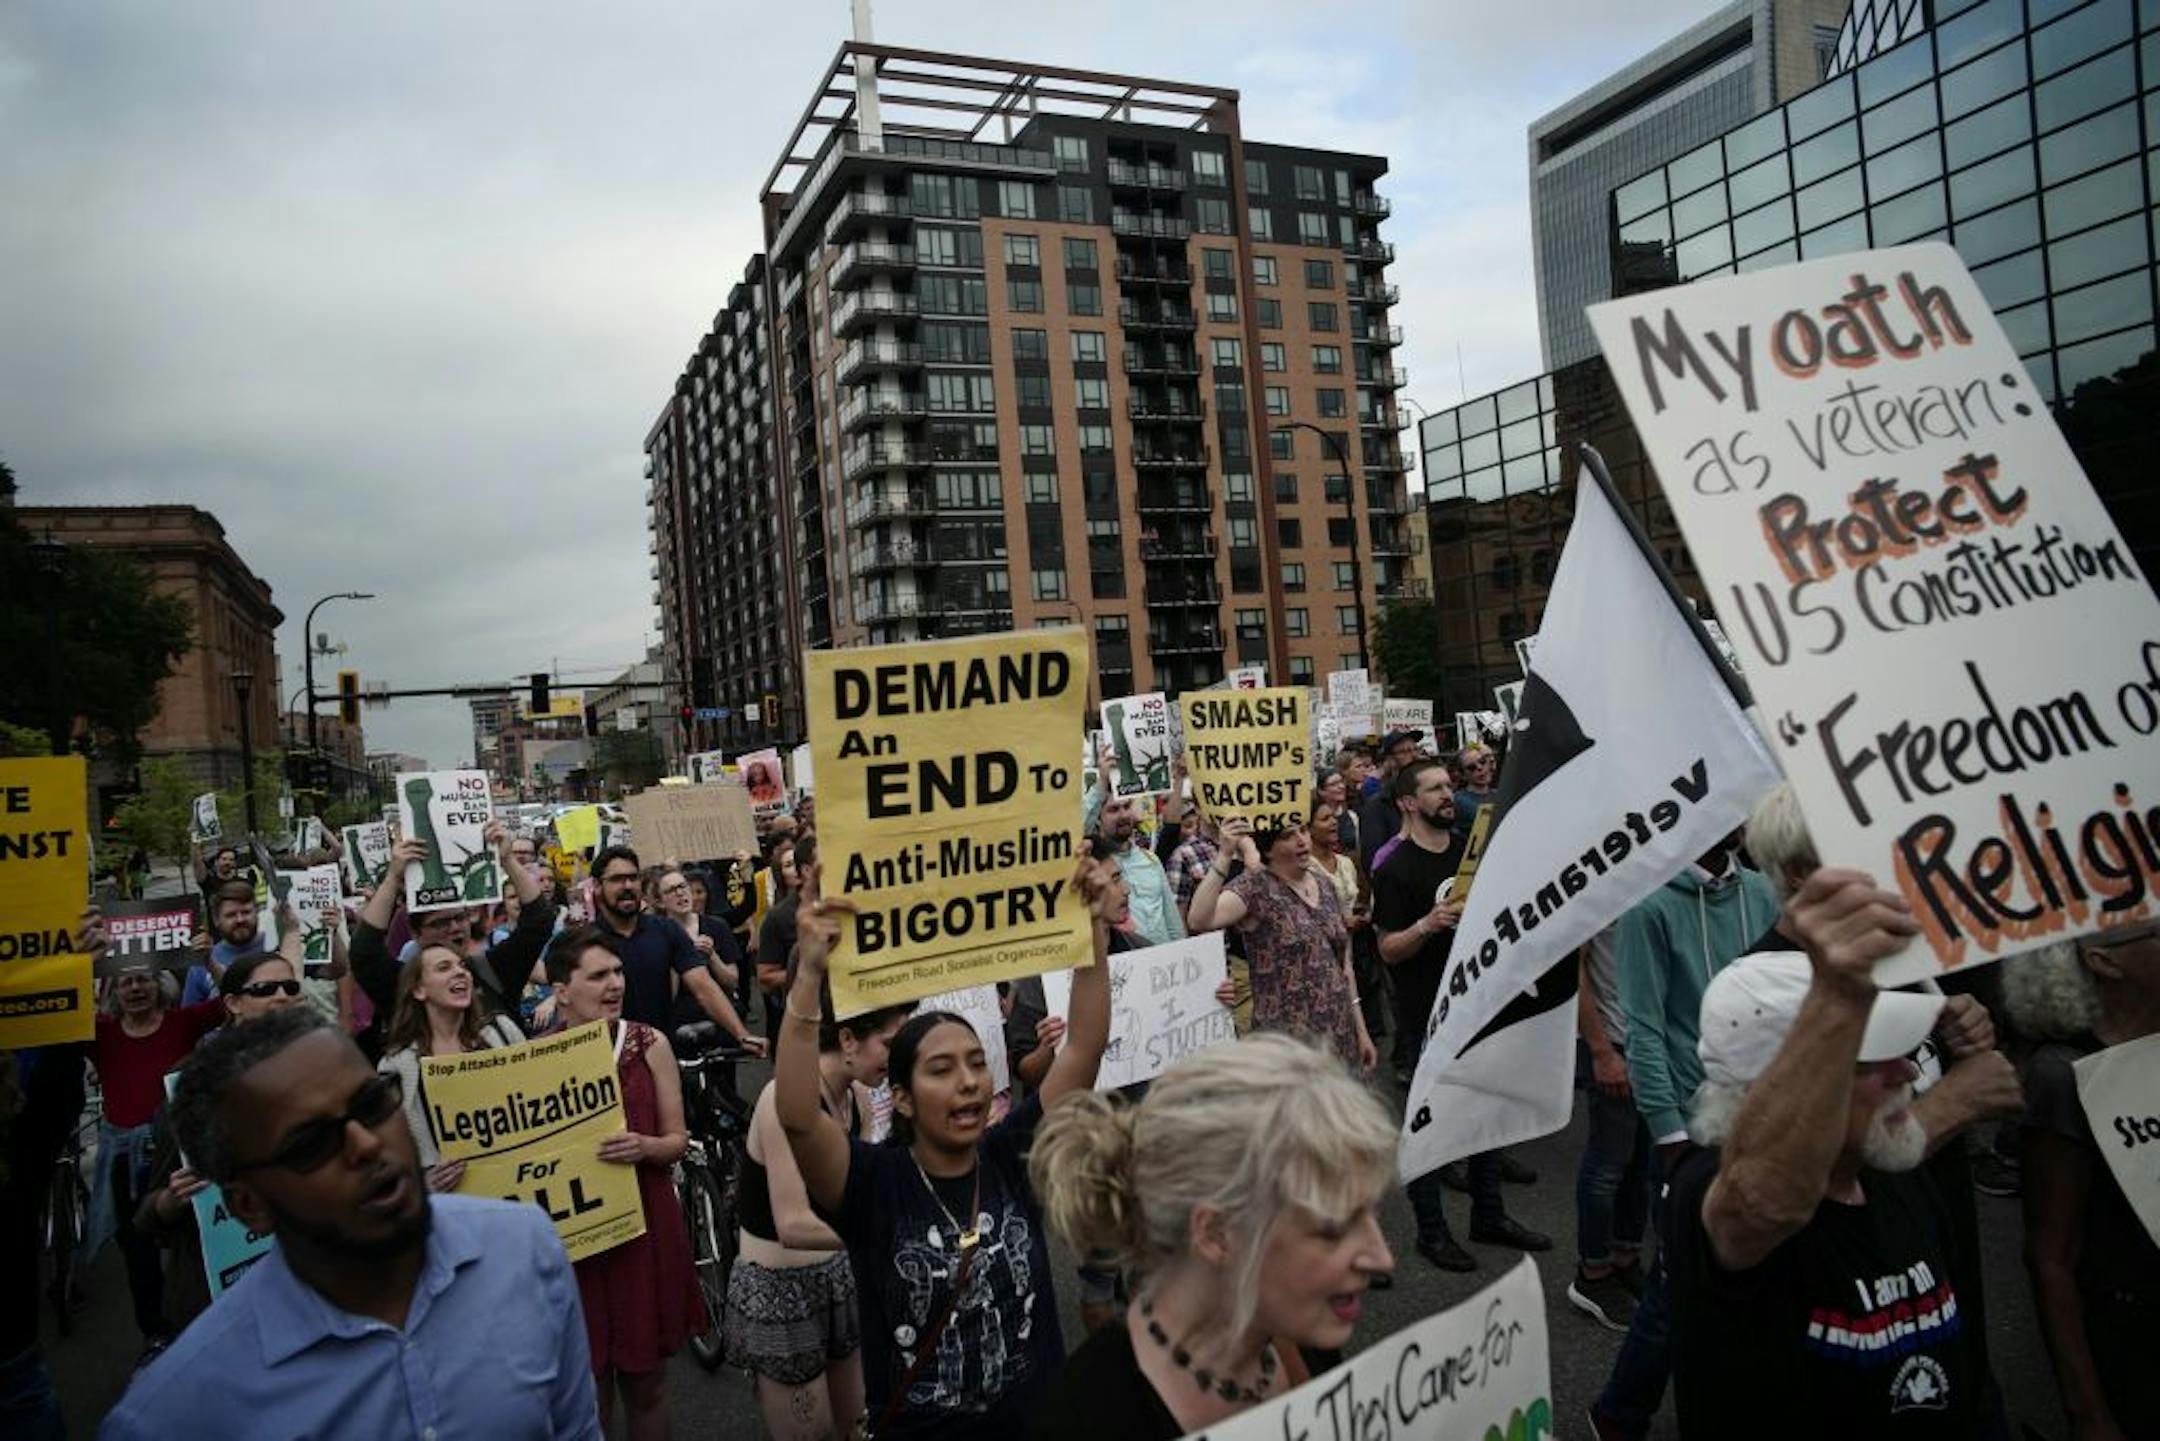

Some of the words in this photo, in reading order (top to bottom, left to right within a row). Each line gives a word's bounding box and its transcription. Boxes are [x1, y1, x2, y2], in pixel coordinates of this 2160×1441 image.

[1630, 308, 1758, 414] My
[1772, 271, 1973, 379] oath
[1684, 430, 1771, 495] as
[1787, 373, 2033, 471] veteran:
[1760, 451, 2029, 586] Protect
[1732, 579, 1846, 667] US
[1855, 524, 2138, 635] Constitution
[834, 651, 1070, 720] DEMAND
[1143, 699, 1163, 710] NO
[1134, 725, 1165, 738] EVER
[1191, 697, 1298, 729] SMASH
[1385, 708, 1403, 720] WE
[1405, 708, 1429, 720] ARE
[838, 730, 897, 758] An
[1189, 741, 1304, 770] TRUMP's
[440, 793, 486, 802] MUSLIM
[458, 778, 484, 791] NO
[867, 751, 1018, 819] END
[1029, 764, 1068, 792] To
[1203, 779, 1302, 807] RACIST
[447, 812, 488, 826] EVER
[843, 826, 1072, 893] Anti-Muslim
[111, 912, 190, 934] DESERVE
[856, 879, 1065, 954] BIGOTRY
[858, 973, 911, 992] Freedom
[913, 962, 944, 977] Road
[947, 956, 993, 973] Socialist
[996, 943, 1069, 964] Organization
[427, 1063, 456, 1077] Stop
[458, 1055, 507, 1073] Attacks
[510, 1052, 526, 1063] on
[530, 1026, 602, 1057] Immigrants!
[434, 1074, 616, 1148] Legalization
[516, 1158, 561, 1184] For
[503, 1176, 603, 1222] LL
[1855, 1278, 1873, 1312] I
[1874, 1273, 1908, 1307] am
[1395, 1342, 1478, 1425] Came
[1479, 1298, 1525, 1389] for
